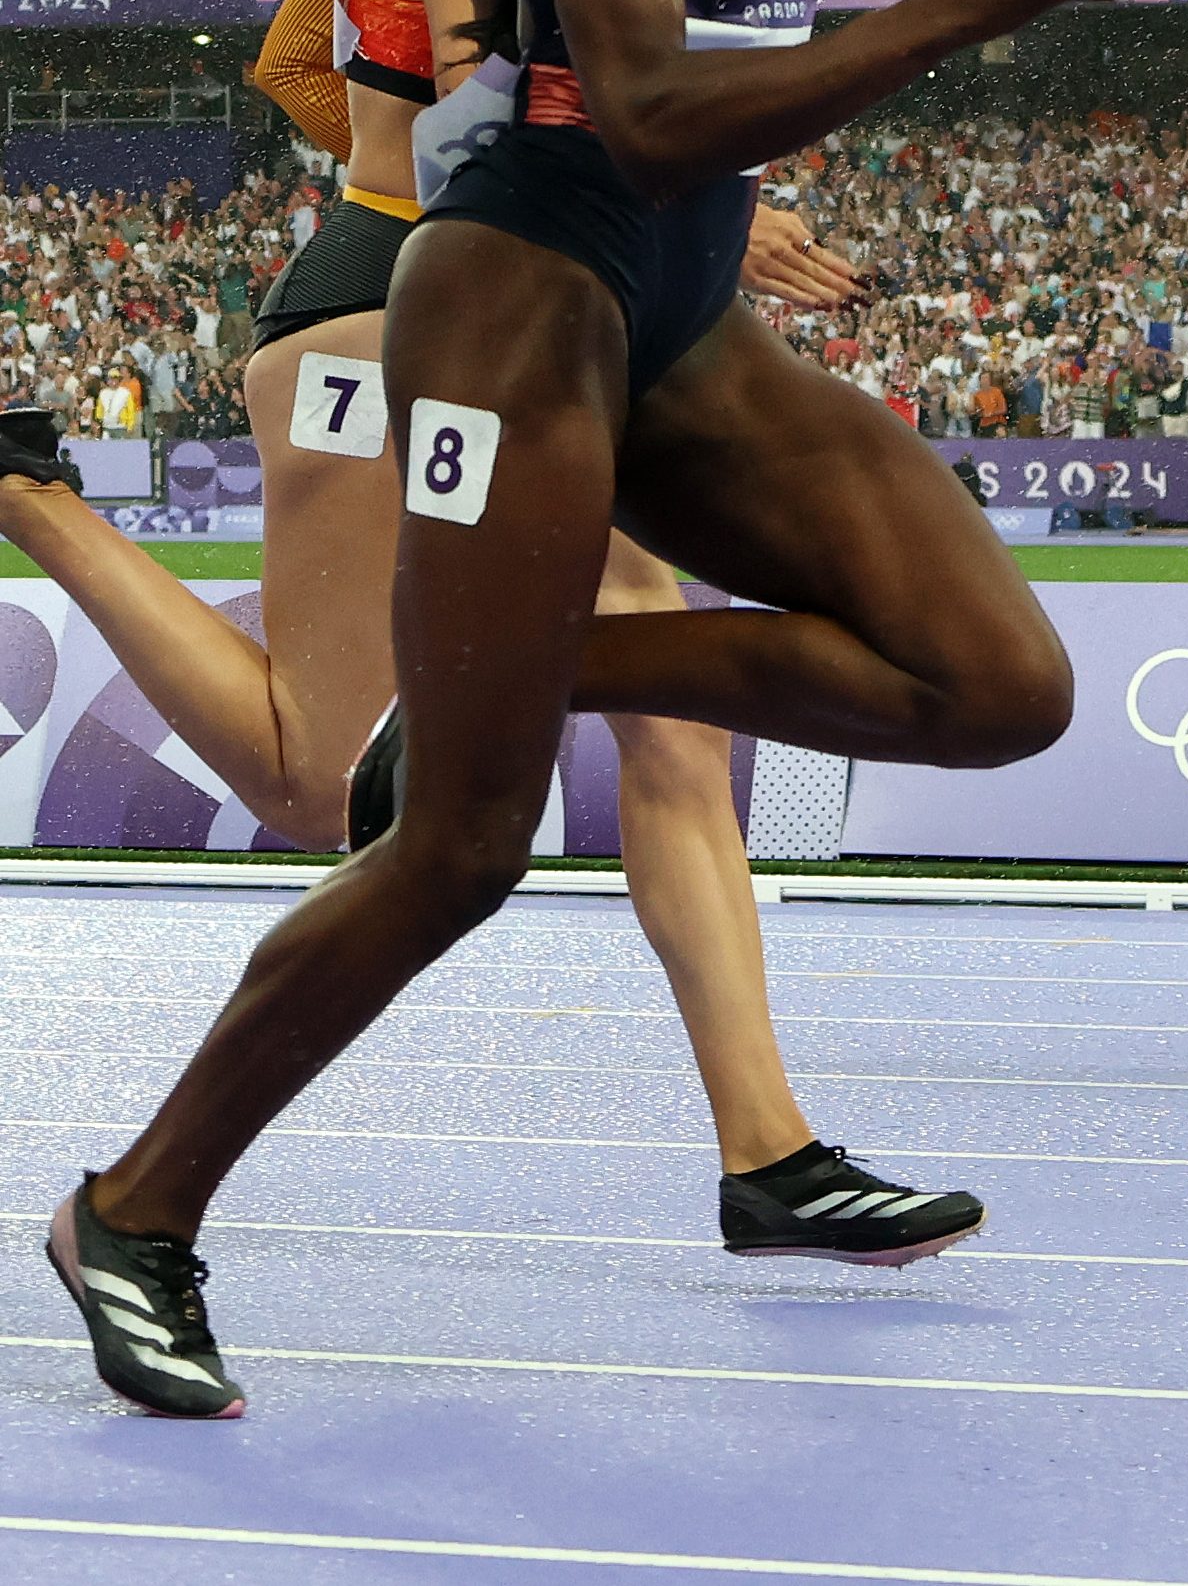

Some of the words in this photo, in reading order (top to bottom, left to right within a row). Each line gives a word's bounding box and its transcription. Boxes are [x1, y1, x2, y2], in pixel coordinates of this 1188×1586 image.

[323, 375, 361, 433] 7
[425, 427, 464, 494] 8
[1024, 460, 1168, 500] 2024
